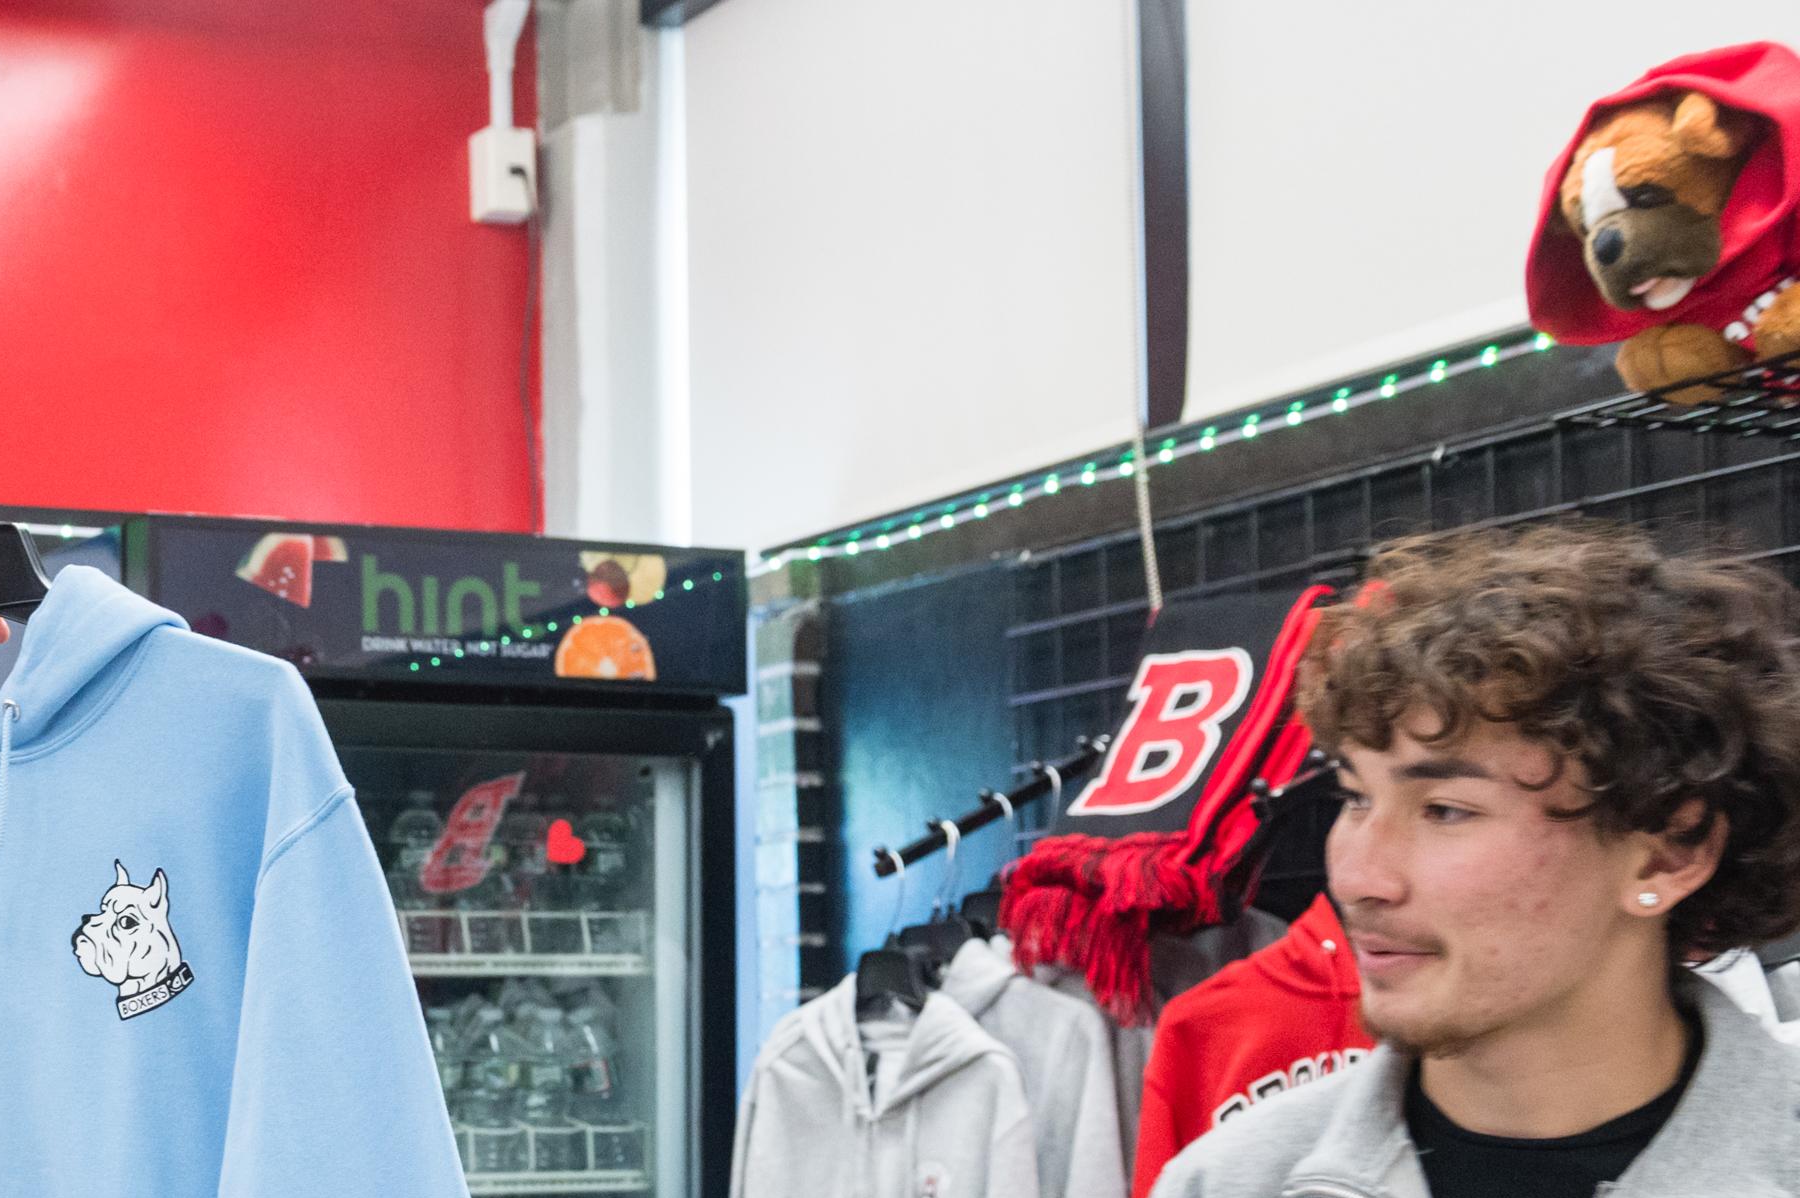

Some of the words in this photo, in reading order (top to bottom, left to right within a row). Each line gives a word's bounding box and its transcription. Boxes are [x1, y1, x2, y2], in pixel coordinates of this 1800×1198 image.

[362, 554, 546, 637] hint
[1067, 647, 1252, 816] B
[121, 987, 168, 1016] BOXERS
